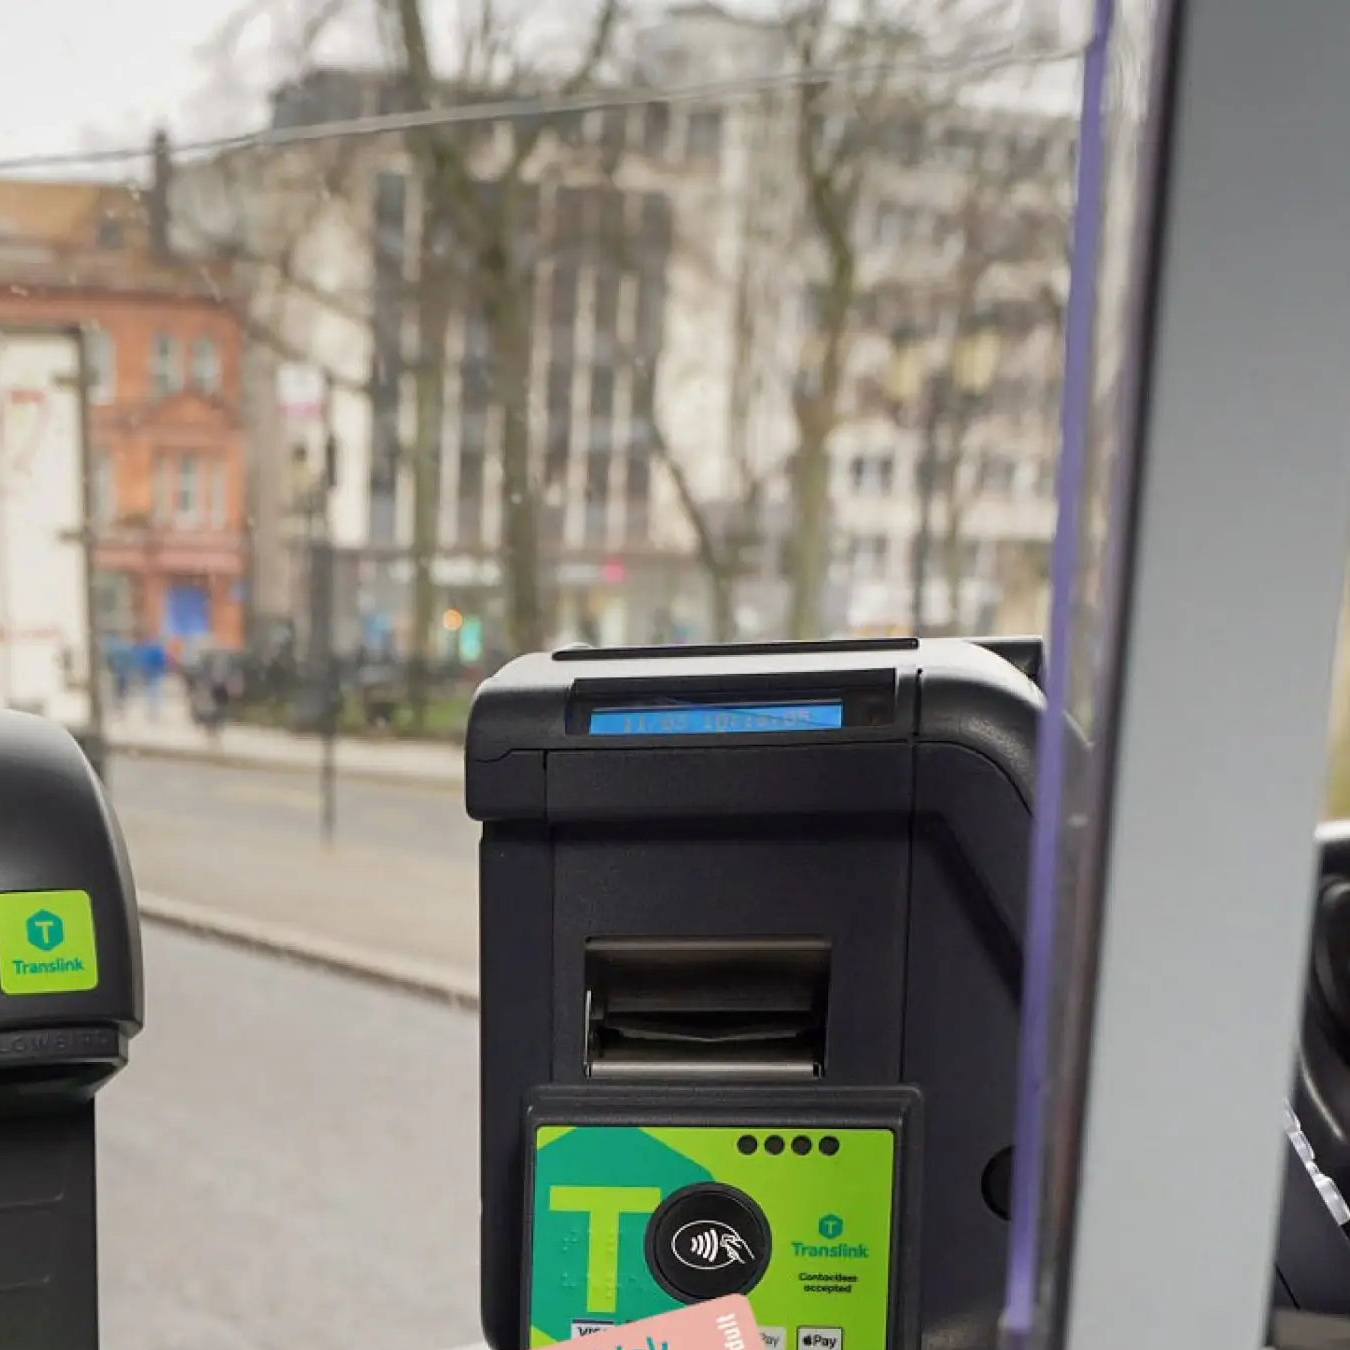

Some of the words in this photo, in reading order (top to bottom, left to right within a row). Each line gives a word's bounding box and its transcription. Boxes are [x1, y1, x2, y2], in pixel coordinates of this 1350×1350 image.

[12, 956, 85, 976] Translink
[549, 1185, 662, 1313] T
[791, 1241, 869, 1258] Translink
[803, 1284, 852, 1294] accepted
[813, 1333, 837, 1350] Pay
